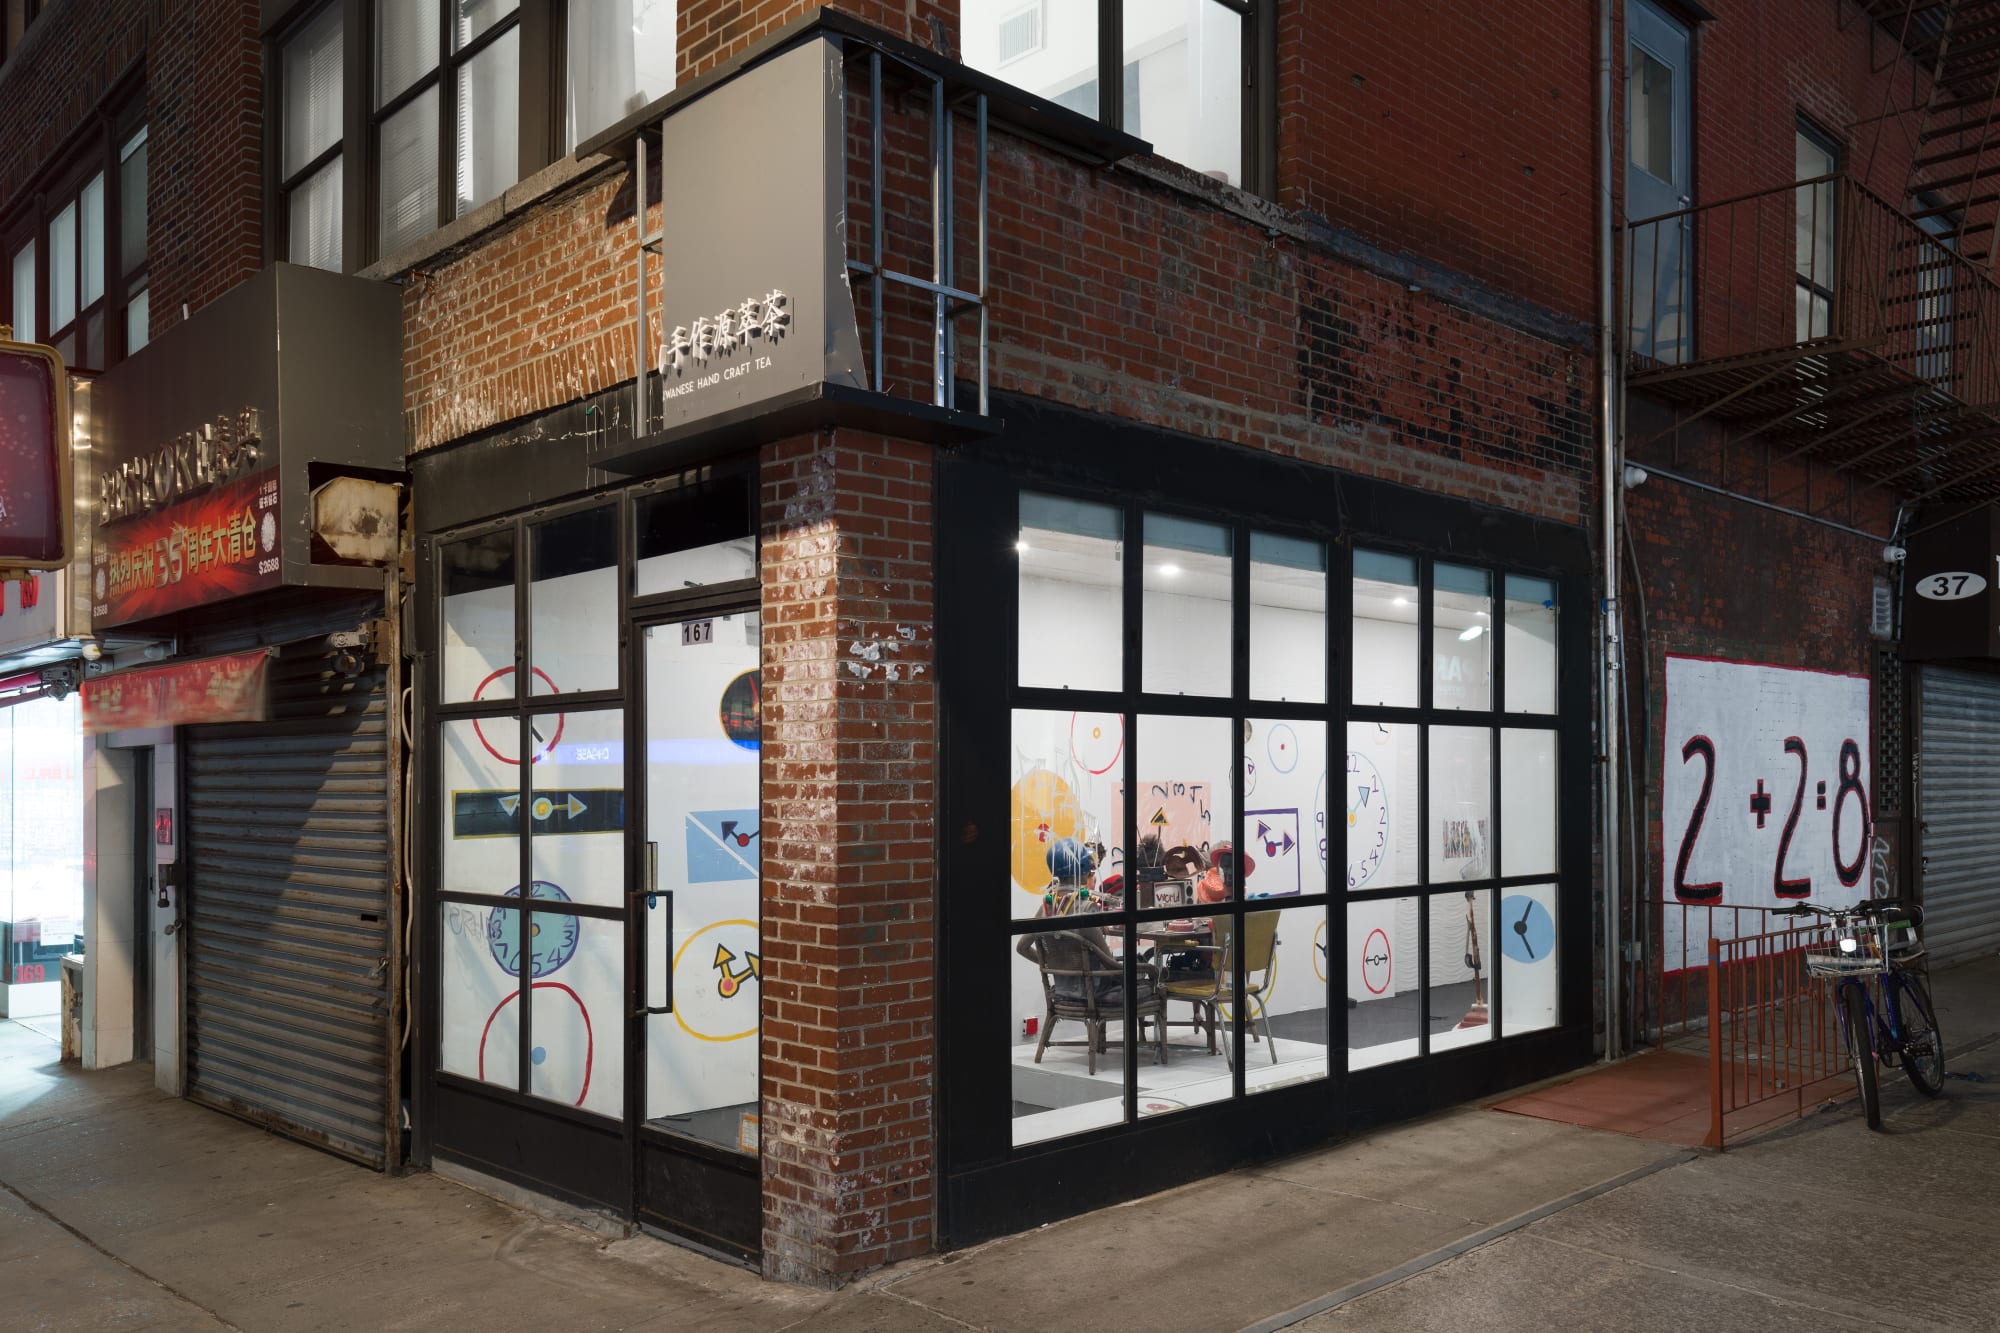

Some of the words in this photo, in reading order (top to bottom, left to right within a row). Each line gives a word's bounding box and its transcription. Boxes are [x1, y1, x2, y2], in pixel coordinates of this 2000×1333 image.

[659, 289, 790, 374] 手作源萃茶
[698, 372, 720, 389] HAND
[724, 361, 751, 380] CRAFT
[755, 356, 772, 370] TEA
[258, 556, 280, 576] $2688
[1932, 575, 1970, 597] 37
[684, 622, 711, 643] 167
[1316, 811, 1325, 829] 9
[1380, 806, 1387, 825] 2
[1376, 831, 1384, 848] 3
[1369, 848, 1379, 866] 4
[1347, 863, 1356, 887] 6
[1361, 860, 1368, 879] 5
[560, 930, 574, 948] 3
[494, 942, 509, 959] 7
[547, 947, 563, 966] 4
[16, 963, 45, 984] 169
